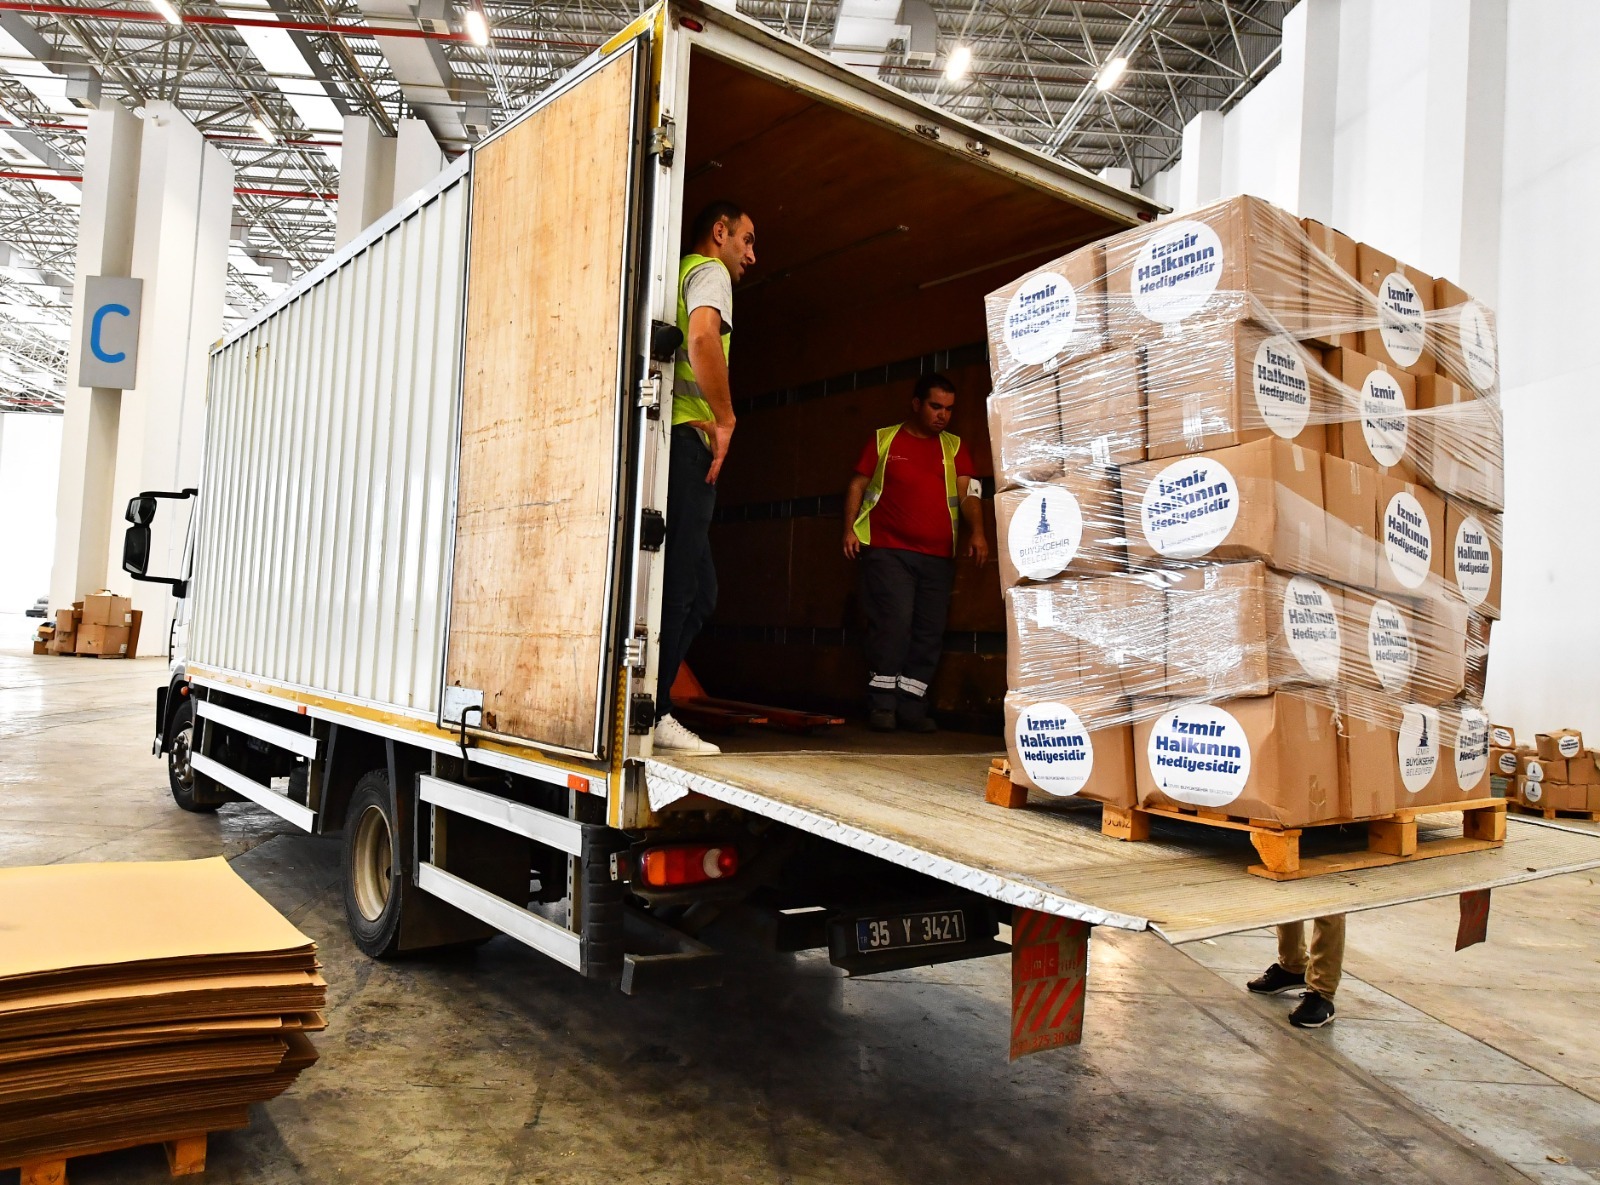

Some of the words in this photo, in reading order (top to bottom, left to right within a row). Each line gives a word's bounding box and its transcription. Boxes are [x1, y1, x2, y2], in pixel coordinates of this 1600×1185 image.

[1152, 233, 1199, 260] İzmir
[1138, 246, 1215, 281] Halkının
[1140, 261, 1216, 294] Hediyesidir
[1020, 284, 1057, 308] İzmir
[1386, 282, 1414, 303] İzmir
[1383, 301, 1420, 316] lkının
[90, 303, 130, 363] C
[1266, 346, 1295, 371] İzmir
[1257, 364, 1306, 391] Halkının
[1259, 383, 1307, 405] Hediyesidir
[1370, 381, 1395, 400] İzmir
[1159, 470, 1207, 497] İzmir
[1147, 482, 1228, 519] Halkının
[1151, 498, 1230, 531] Hediyesidir
[1397, 500, 1422, 528] İzmir
[1388, 515, 1429, 549] Halkının
[1463, 528, 1482, 545] İzmir
[1388, 531, 1428, 561] Hediyesidir
[1457, 546, 1489, 561] Halkının
[1459, 562, 1489, 575] Hediyesidir
[1293, 587, 1323, 606] İzmir
[1288, 608, 1335, 625] Halkının
[1376, 612, 1399, 630] İzmir
[1372, 632, 1408, 647] Halkının
[1375, 650, 1408, 664] Hediyesidir
[1027, 714, 1067, 731] İzmir
[1172, 715, 1225, 737] İzmir
[1020, 733, 1084, 748] Halkının
[1156, 736, 1241, 758] Halkının
[1024, 749, 1086, 764] Hediyesidir
[1156, 754, 1241, 775] Hediyesidir
[869, 921, 890, 946] 35
[902, 918, 911, 943] Y
[921, 915, 960, 941] 3421
